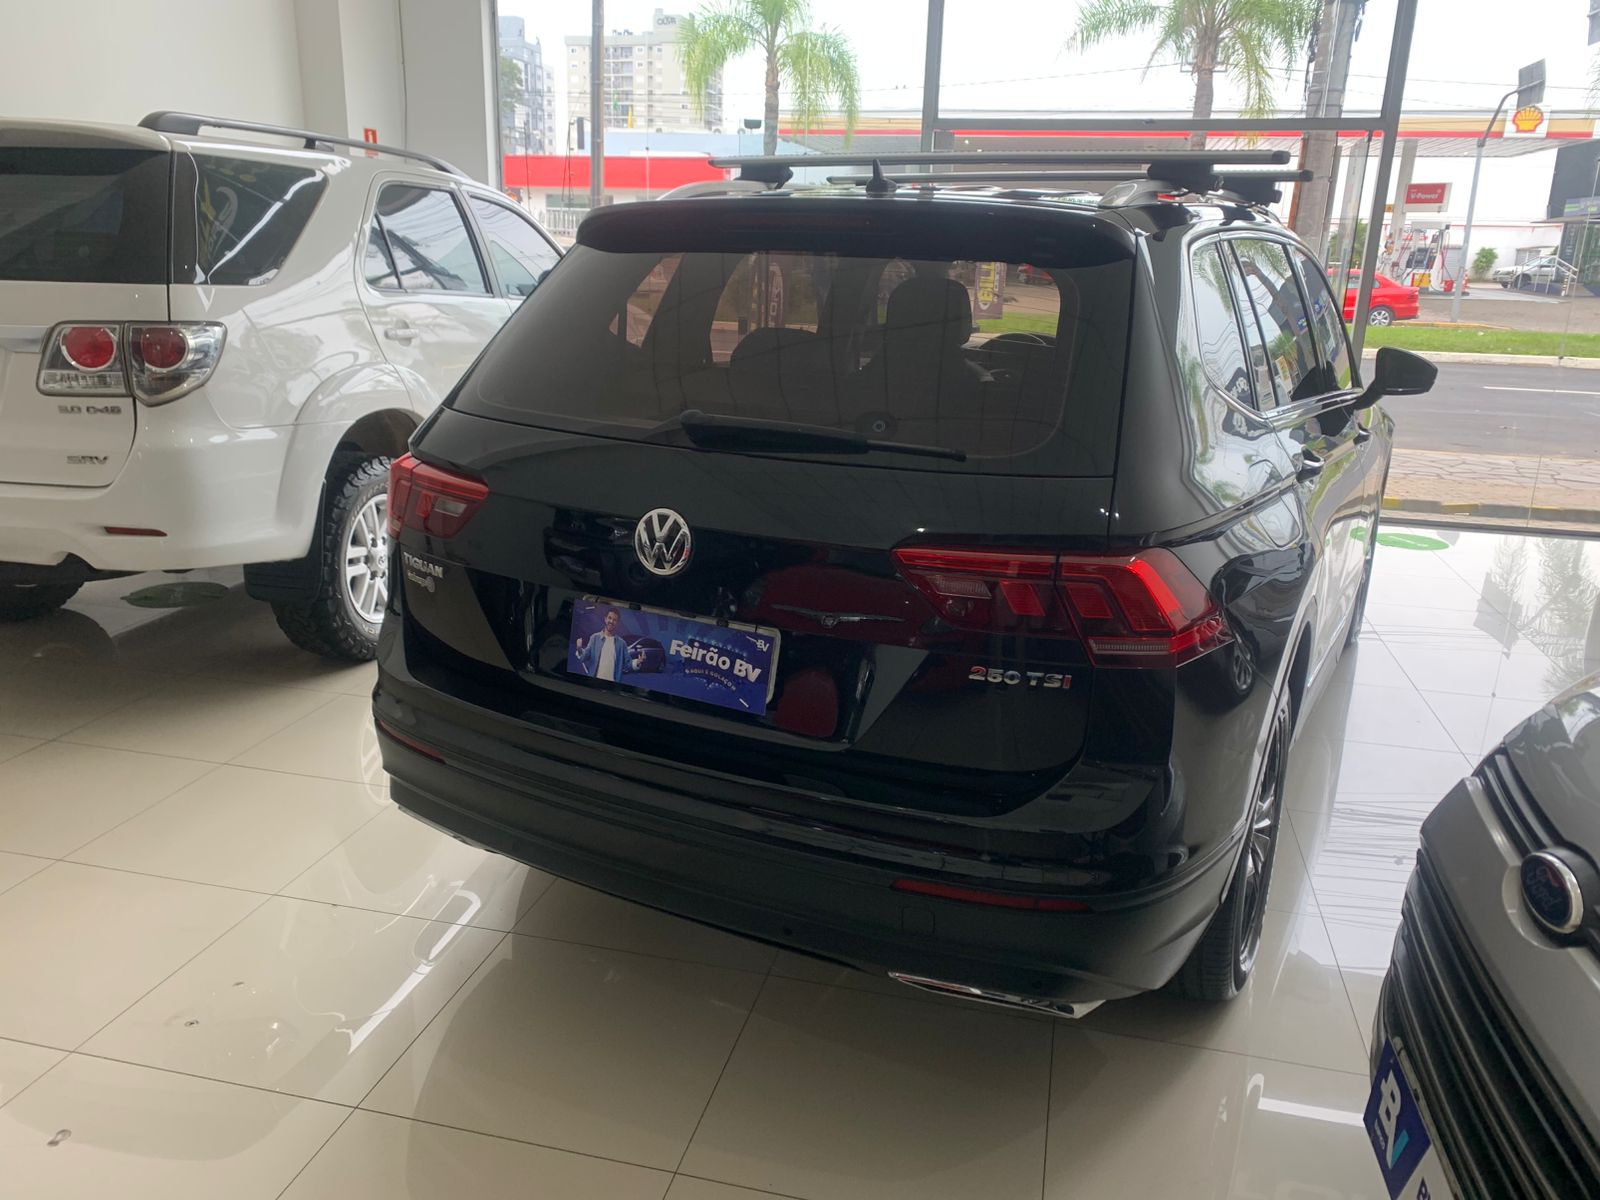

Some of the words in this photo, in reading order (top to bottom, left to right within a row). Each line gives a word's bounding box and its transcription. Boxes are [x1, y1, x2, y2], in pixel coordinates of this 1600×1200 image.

[403, 552, 443, 579] TIGUAN
[669, 640, 731, 670] Feirão
[733, 659, 762, 683] BV
[968, 666, 1021, 685] 250
